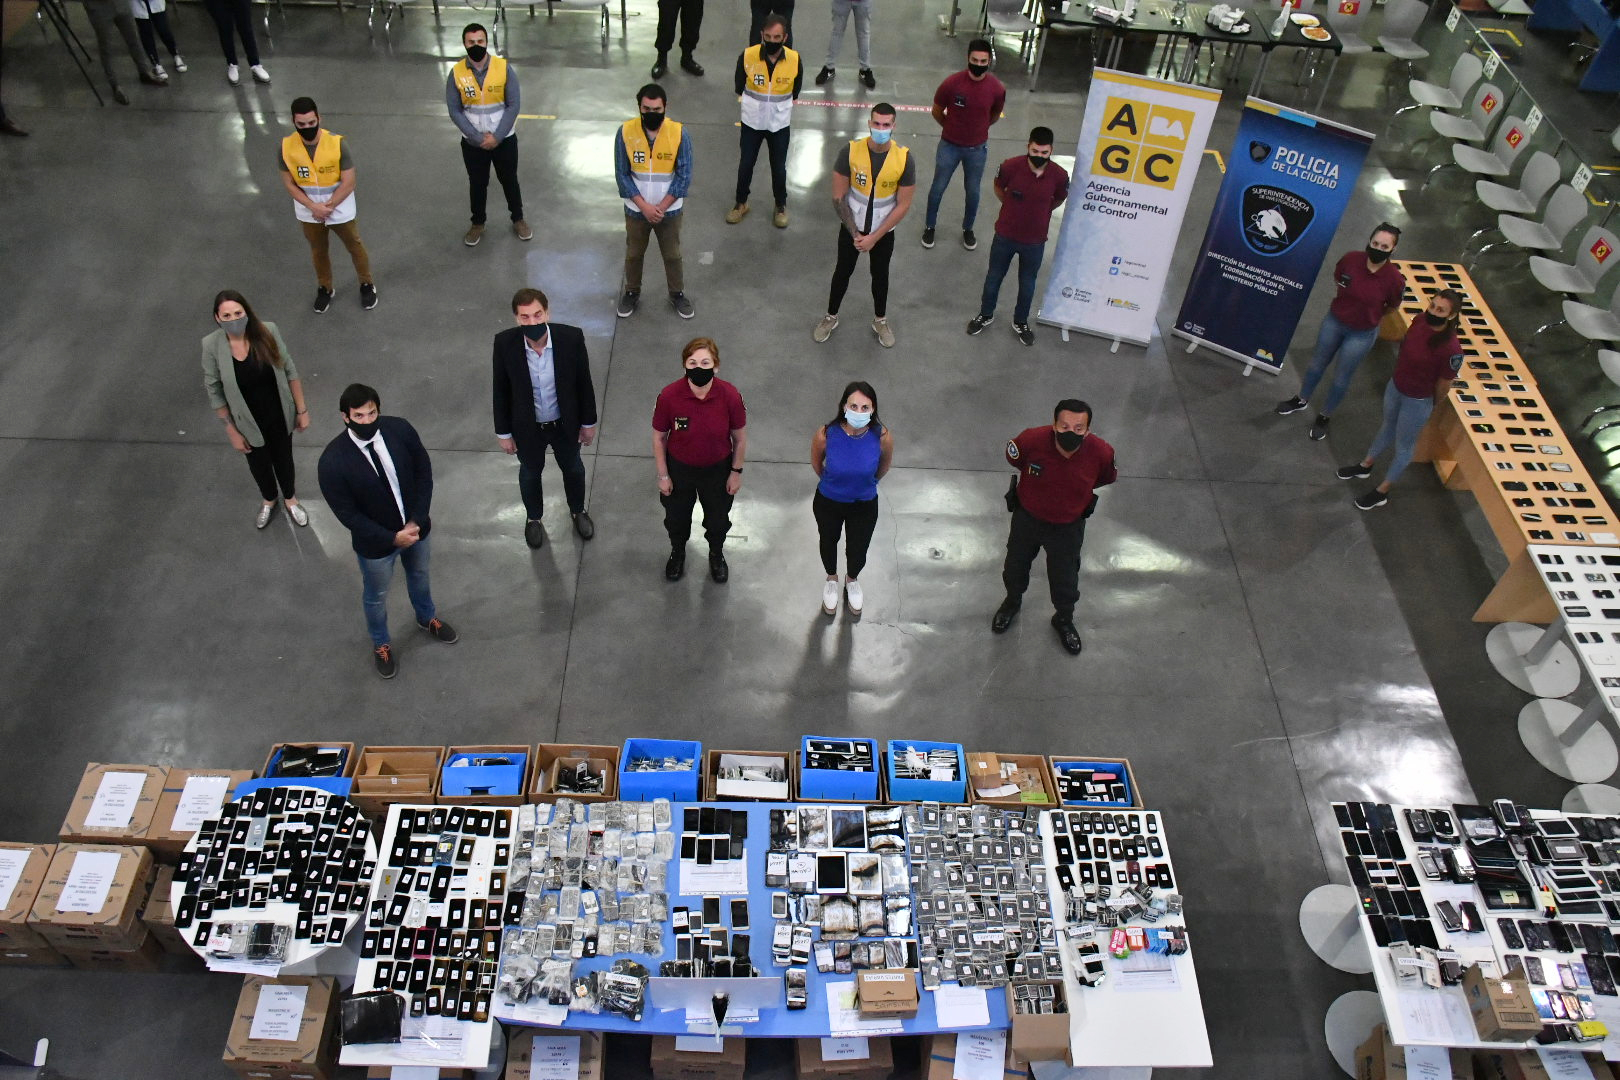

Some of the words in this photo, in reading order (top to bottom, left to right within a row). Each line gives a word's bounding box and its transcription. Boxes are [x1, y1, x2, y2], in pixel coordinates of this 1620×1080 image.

[1107, 104, 1137, 135] A
[1271, 161, 1286, 172] DE
[1287, 166, 1299, 177] LA
[1300, 171, 1338, 189] CIUDAD
[1275, 146, 1339, 179] POLICIA
[1087, 181, 1131, 196] Agencia
[1252, 187, 1310, 213] SUPERINTENDENCIA
[1082, 202, 1096, 211] de
[1098, 205, 1138, 220] Control
[1085, 191, 1168, 215] Gubernamental
[1207, 251, 1238, 266] DIRECCIÓN
[1238, 261, 1247, 269] DE
[1246, 265, 1272, 277] ASUNTOS
[1271, 274, 1304, 290] JUDICIALES
[1224, 265, 1266, 284] COORDINACIÓN
[1265, 280, 1278, 288] CON
[1222, 272, 1254, 287] MINISTERIO
[1253, 283, 1278, 296] PÚBLICO
